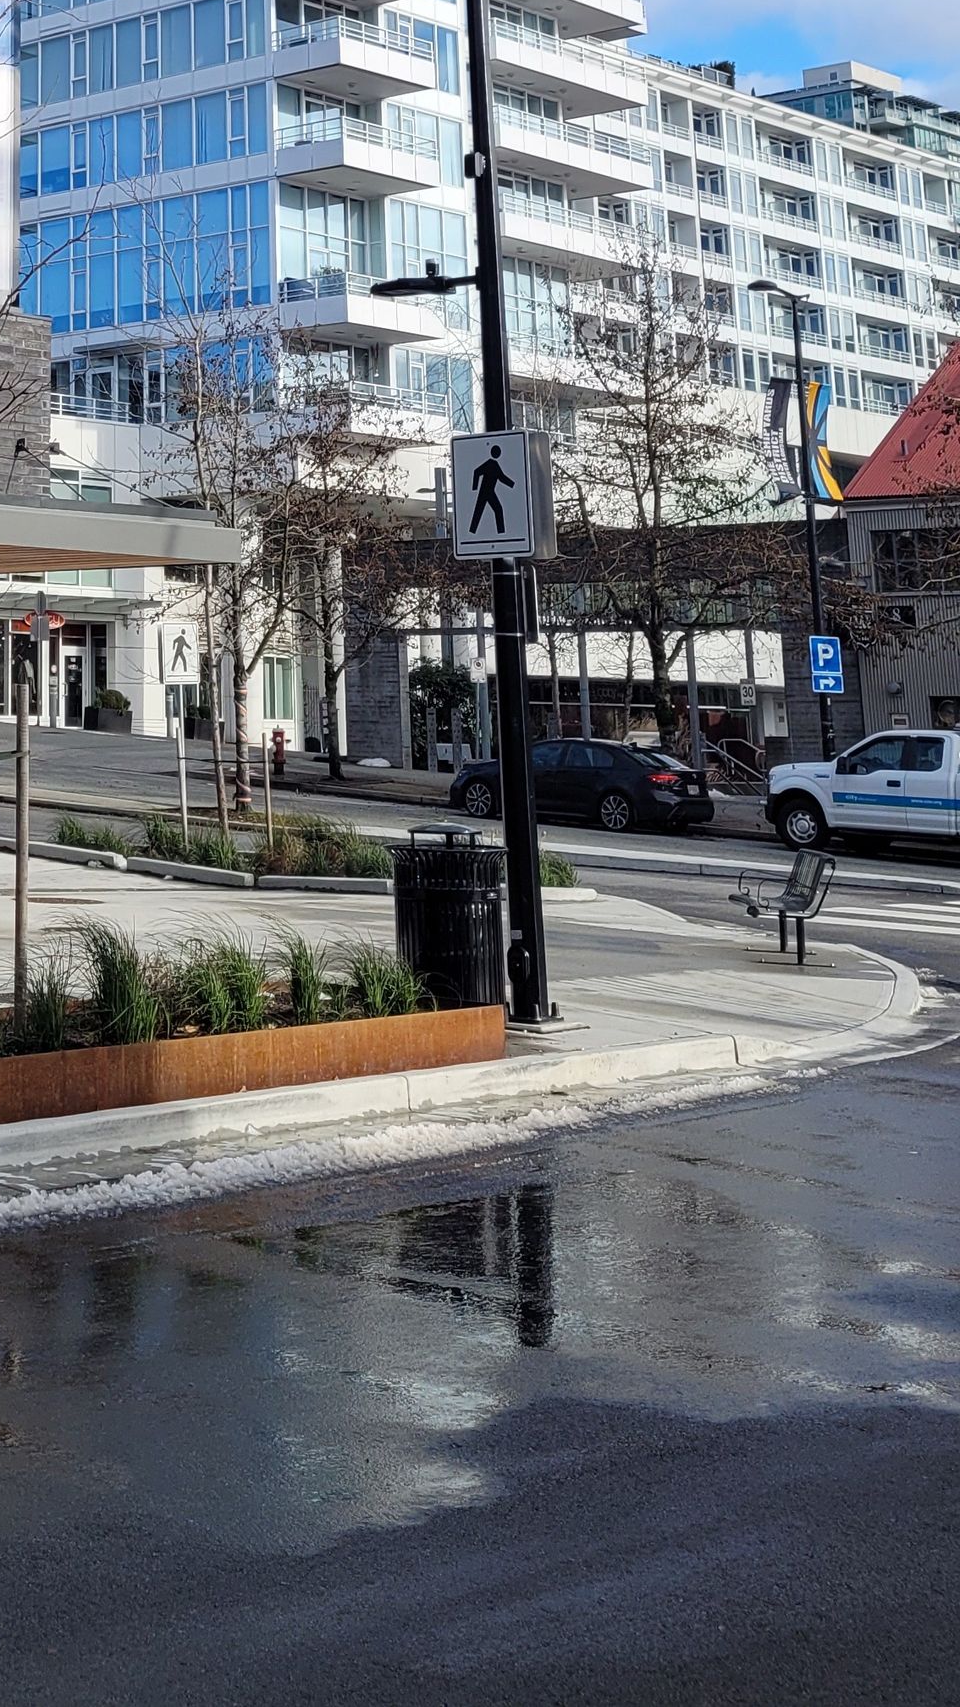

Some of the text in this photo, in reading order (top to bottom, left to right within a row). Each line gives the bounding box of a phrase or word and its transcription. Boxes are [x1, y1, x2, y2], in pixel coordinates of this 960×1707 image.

[762, 388, 780, 483] THE SHIPYARDS
[770, 429, 790, 484] DISTRICT
[817, 643, 834, 667] P
[742, 685, 754, 698] 30
